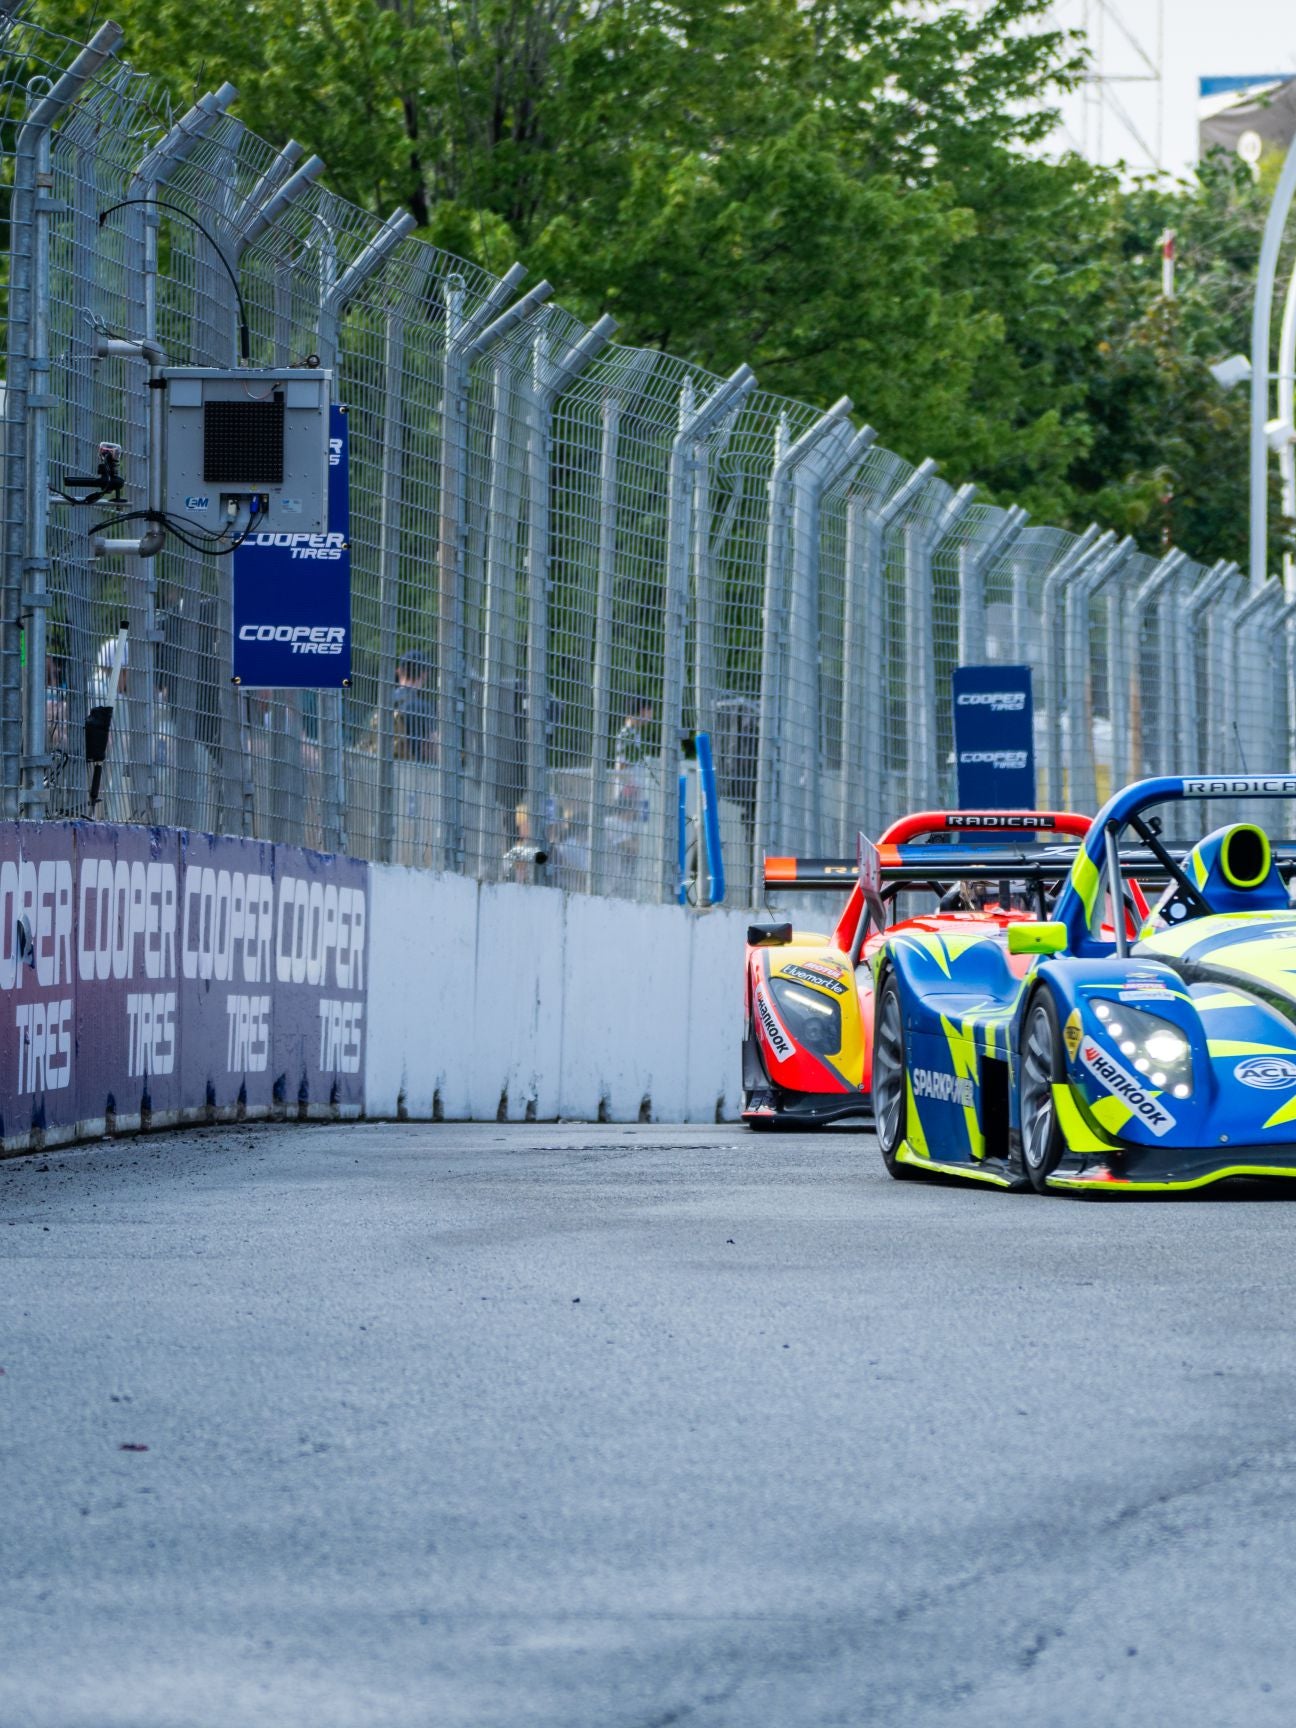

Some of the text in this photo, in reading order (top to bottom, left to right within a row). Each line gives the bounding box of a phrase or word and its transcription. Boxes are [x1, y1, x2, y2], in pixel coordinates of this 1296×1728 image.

[290, 548, 342, 560] TIRES
[238, 624, 346, 643] COOPER
[290, 642, 343, 655] TIRES
[957, 693, 1026, 706] COOPER
[990, 703, 1025, 712] TIRES
[960, 752, 1028, 764] COOPER
[948, 816, 1053, 827] RADICAL
[78, 858, 177, 981] COOPER
[183, 865, 274, 983] COOPER
[276, 876, 366, 991] COOPER
[16, 999, 72, 1095] TIRES
[127, 992, 176, 1077] TIRES
[226, 994, 271, 1073] TIRES
[319, 998, 363, 1073] TIRES
